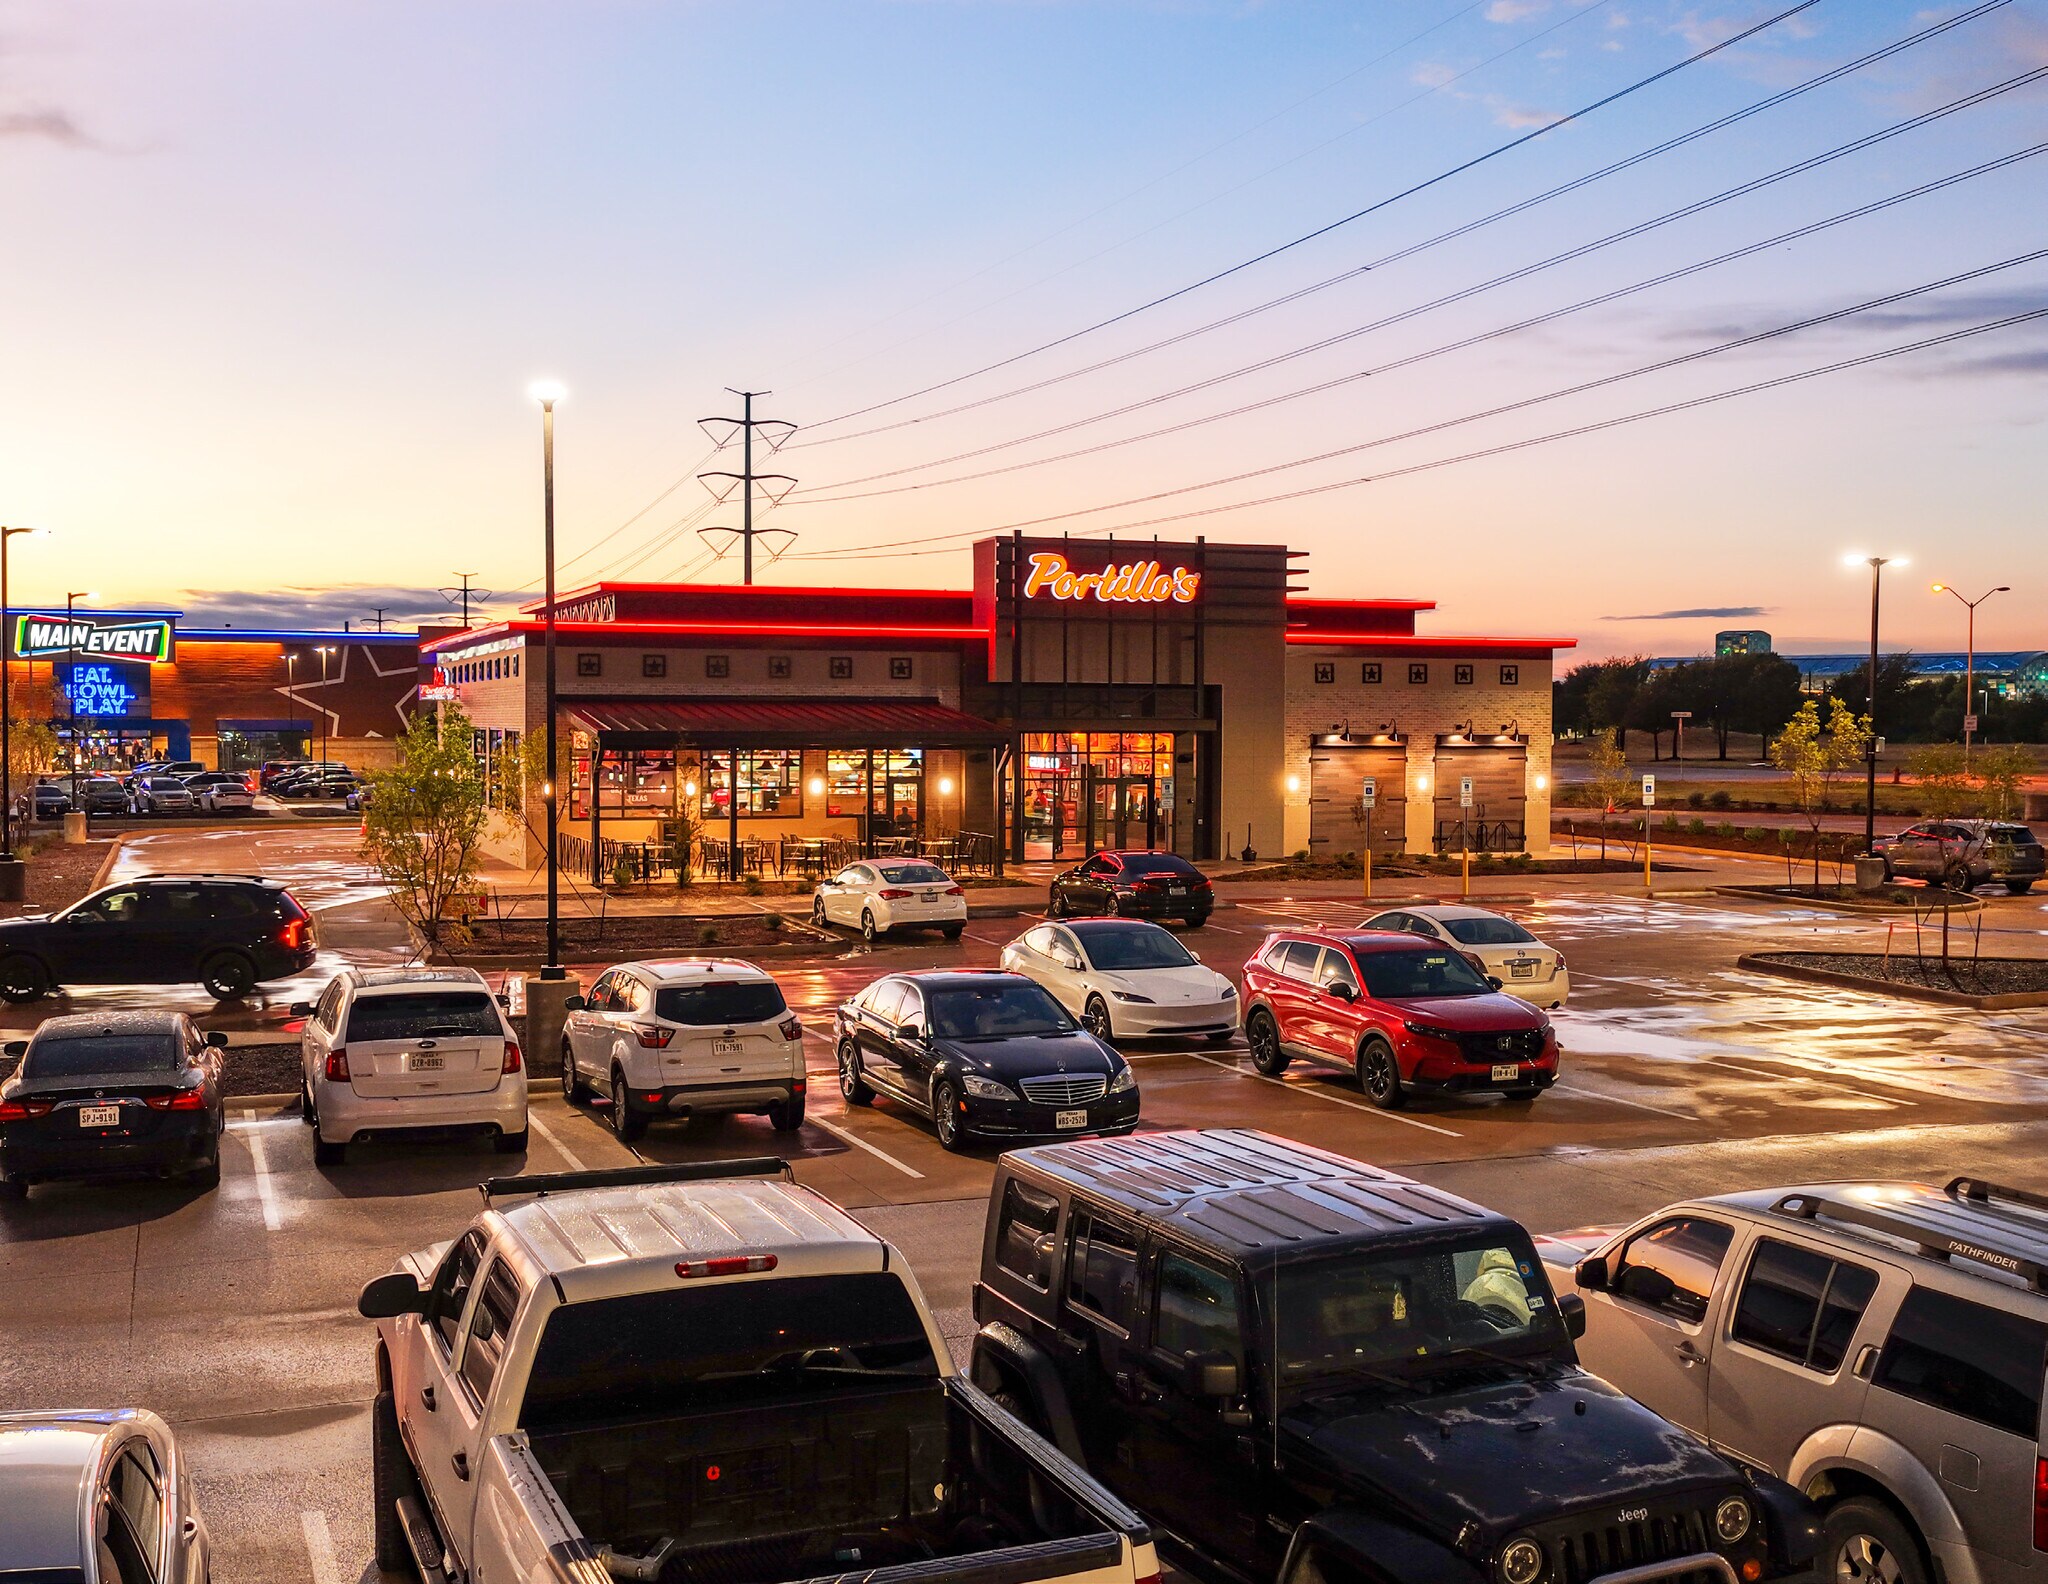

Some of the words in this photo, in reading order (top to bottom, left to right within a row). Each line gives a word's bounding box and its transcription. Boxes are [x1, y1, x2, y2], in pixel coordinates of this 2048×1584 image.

[1024, 553, 1199, 603] Portillo's
[30, 624, 89, 647] MAIN
[87, 628, 159, 653] EVENT
[74, 667, 112, 683] EAT.
[75, 699, 127, 714] PLAY.
[1948, 1241, 2018, 1269] PATHFINDER
[1618, 1508, 1648, 1522] Jeep
